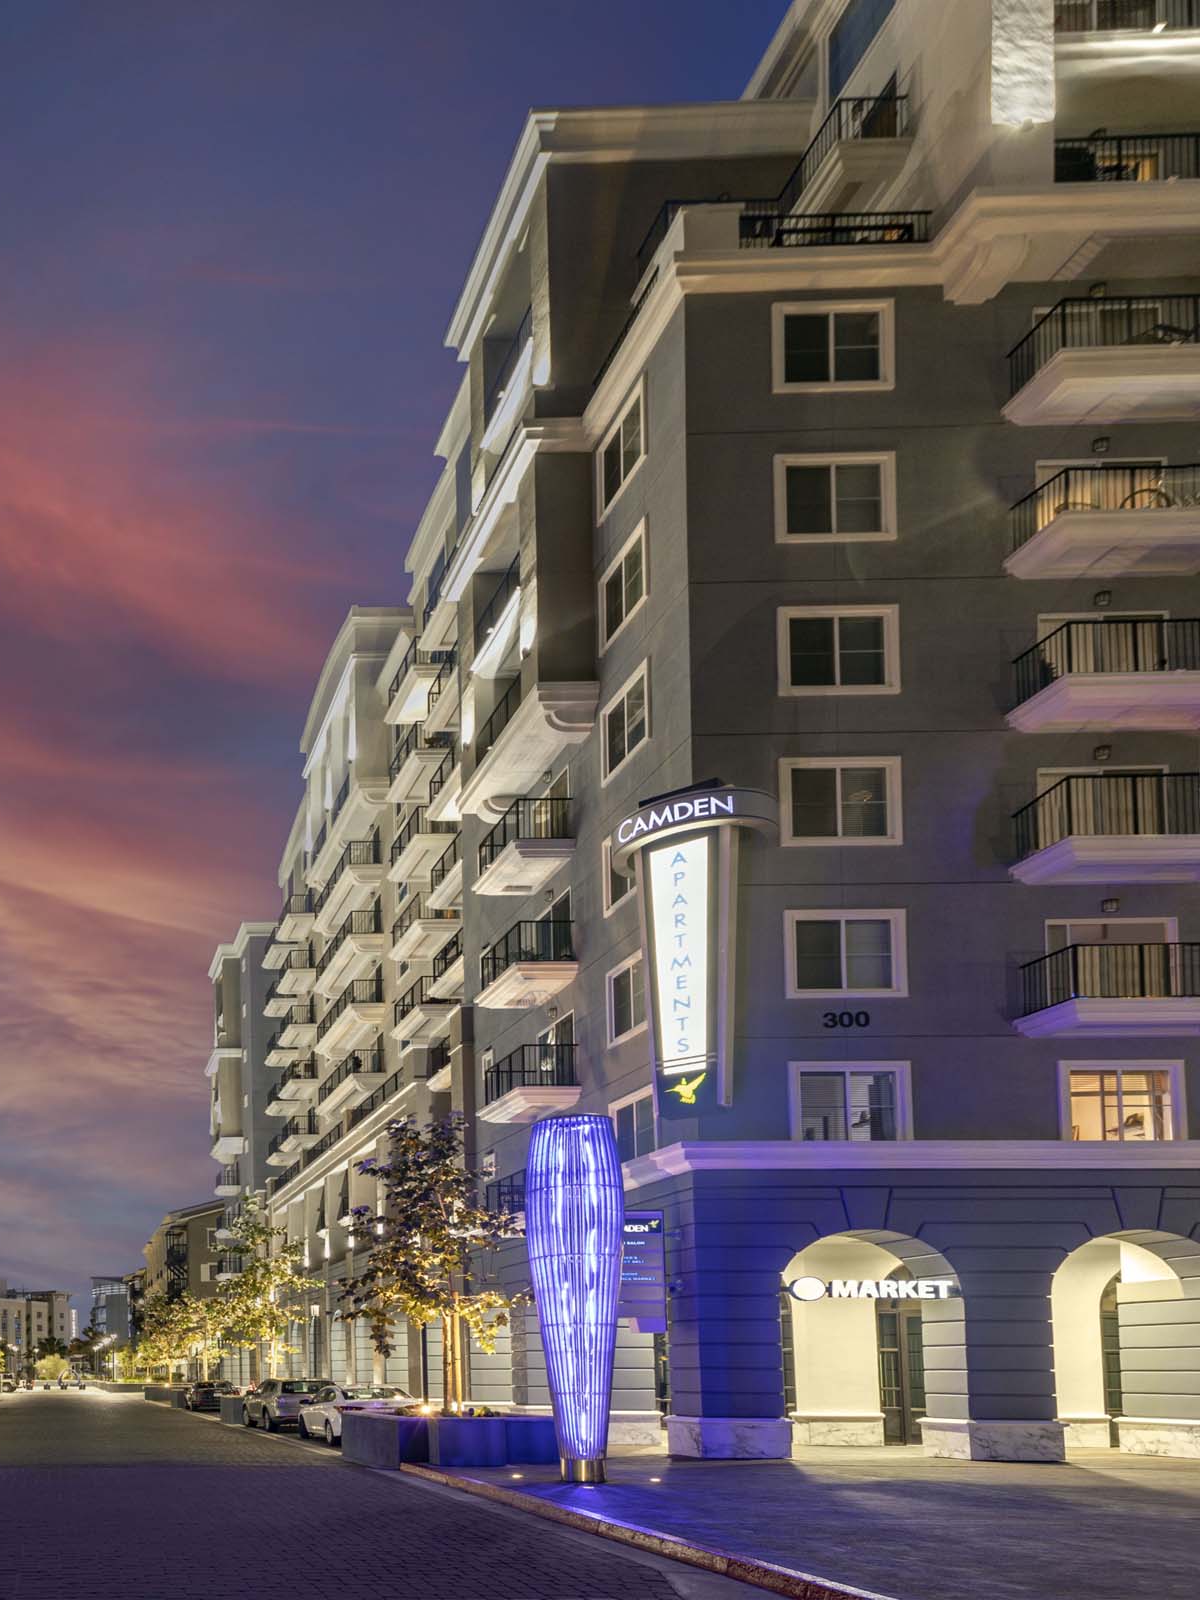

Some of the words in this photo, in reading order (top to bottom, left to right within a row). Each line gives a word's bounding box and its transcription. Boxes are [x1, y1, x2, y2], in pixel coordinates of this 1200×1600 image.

[618, 795, 734, 844] CAMDEN
[670, 851, 692, 1053] APARTMENTS
[823, 1011, 870, 1028] 300
[832, 1279, 953, 1298] MARKET
